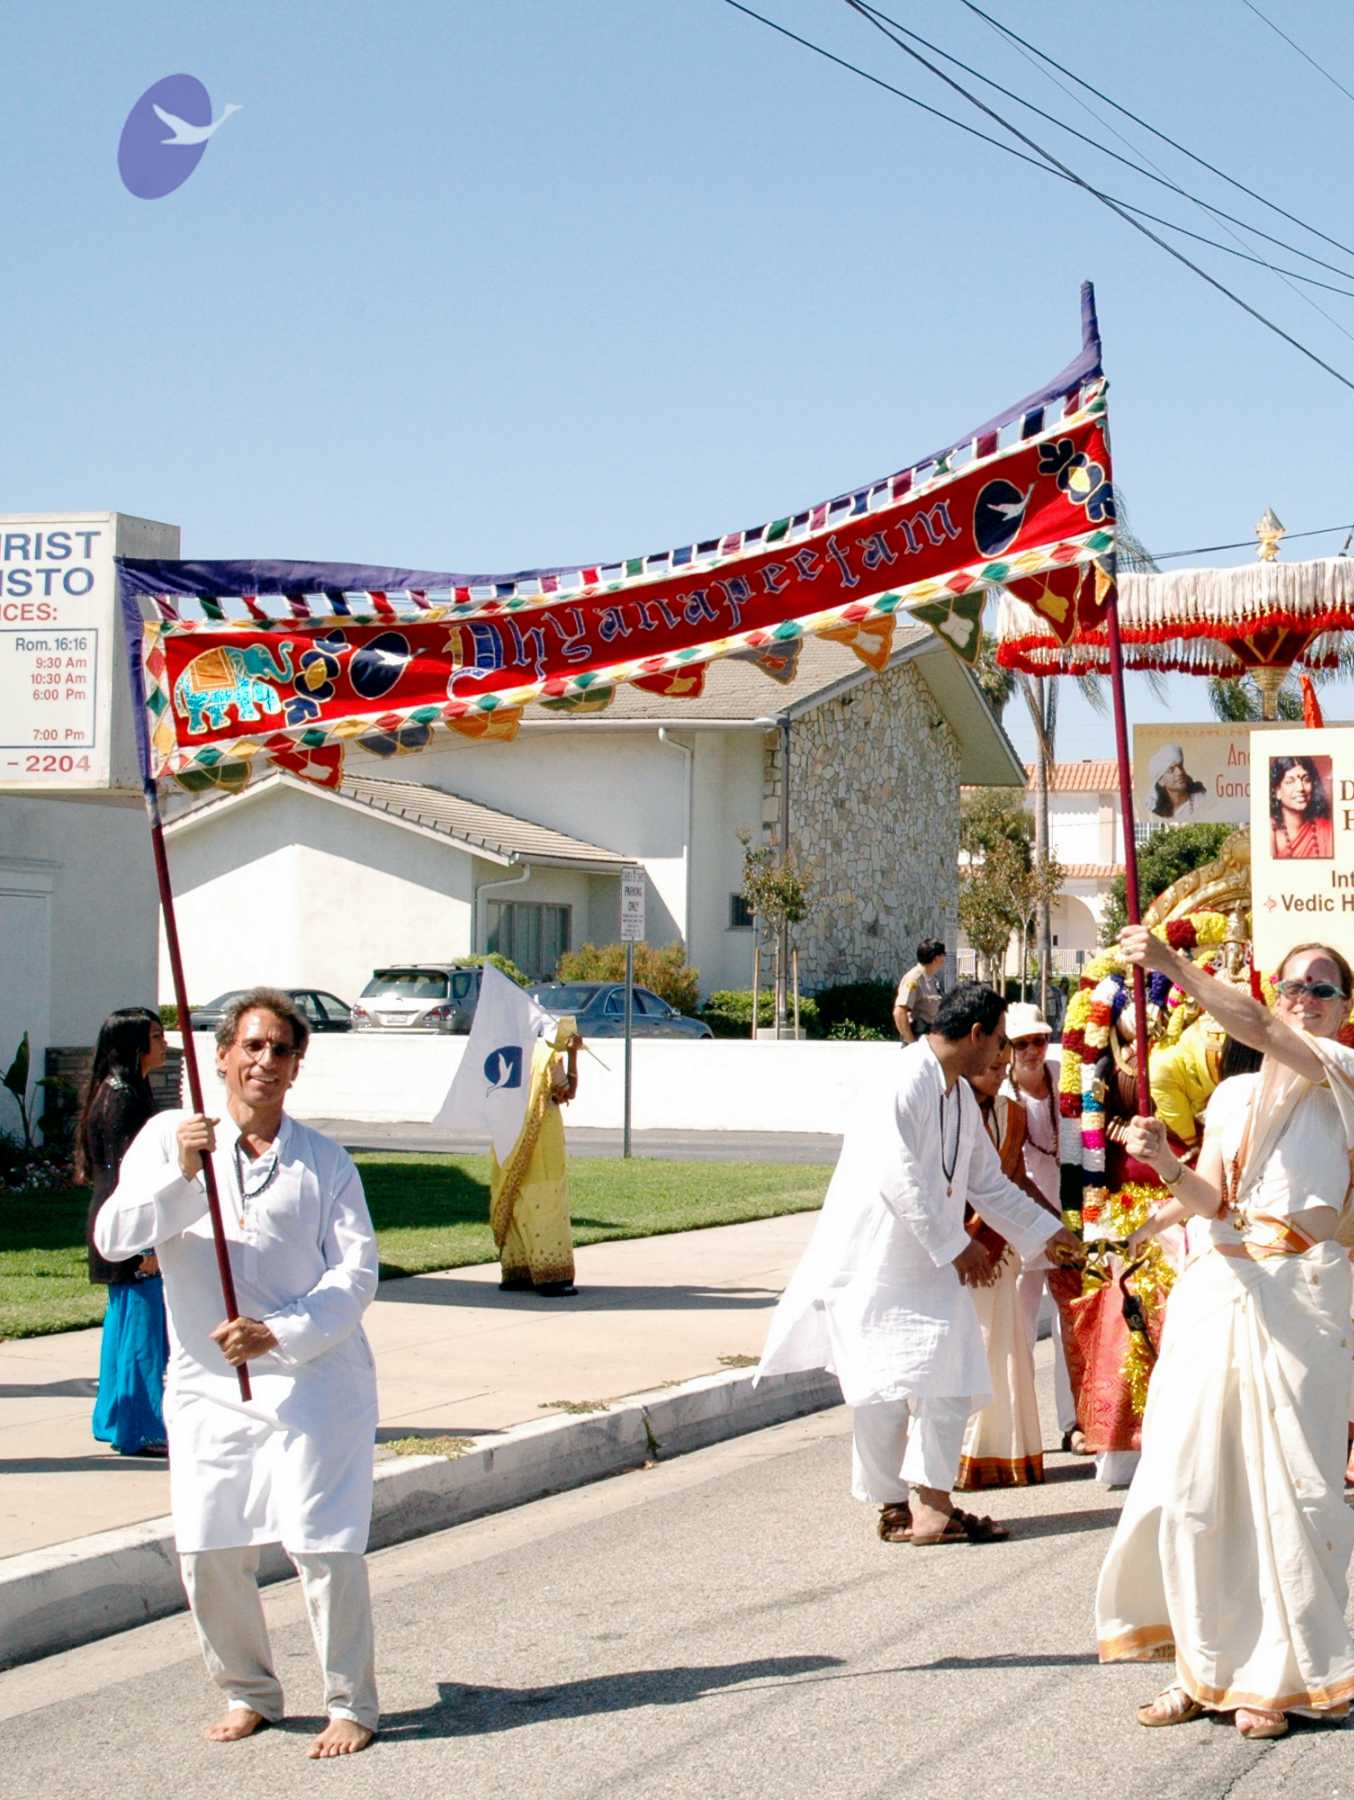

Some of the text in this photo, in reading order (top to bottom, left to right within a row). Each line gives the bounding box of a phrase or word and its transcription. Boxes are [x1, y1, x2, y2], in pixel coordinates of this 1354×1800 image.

[0, 531, 101, 561] RIST
[0, 602, 57, 621] CES:
[15, 637, 87, 651] Rom. 16:16
[35, 657, 87, 669] 9:30 Am
[31, 673, 87, 684] 10:30 Am
[32, 688, 86, 700] 6:00 Pm
[33, 728, 85, 740] 7:00 Pm
[25, 755, 91, 772] 2204
[1281, 894, 1334, 912] Vedic
